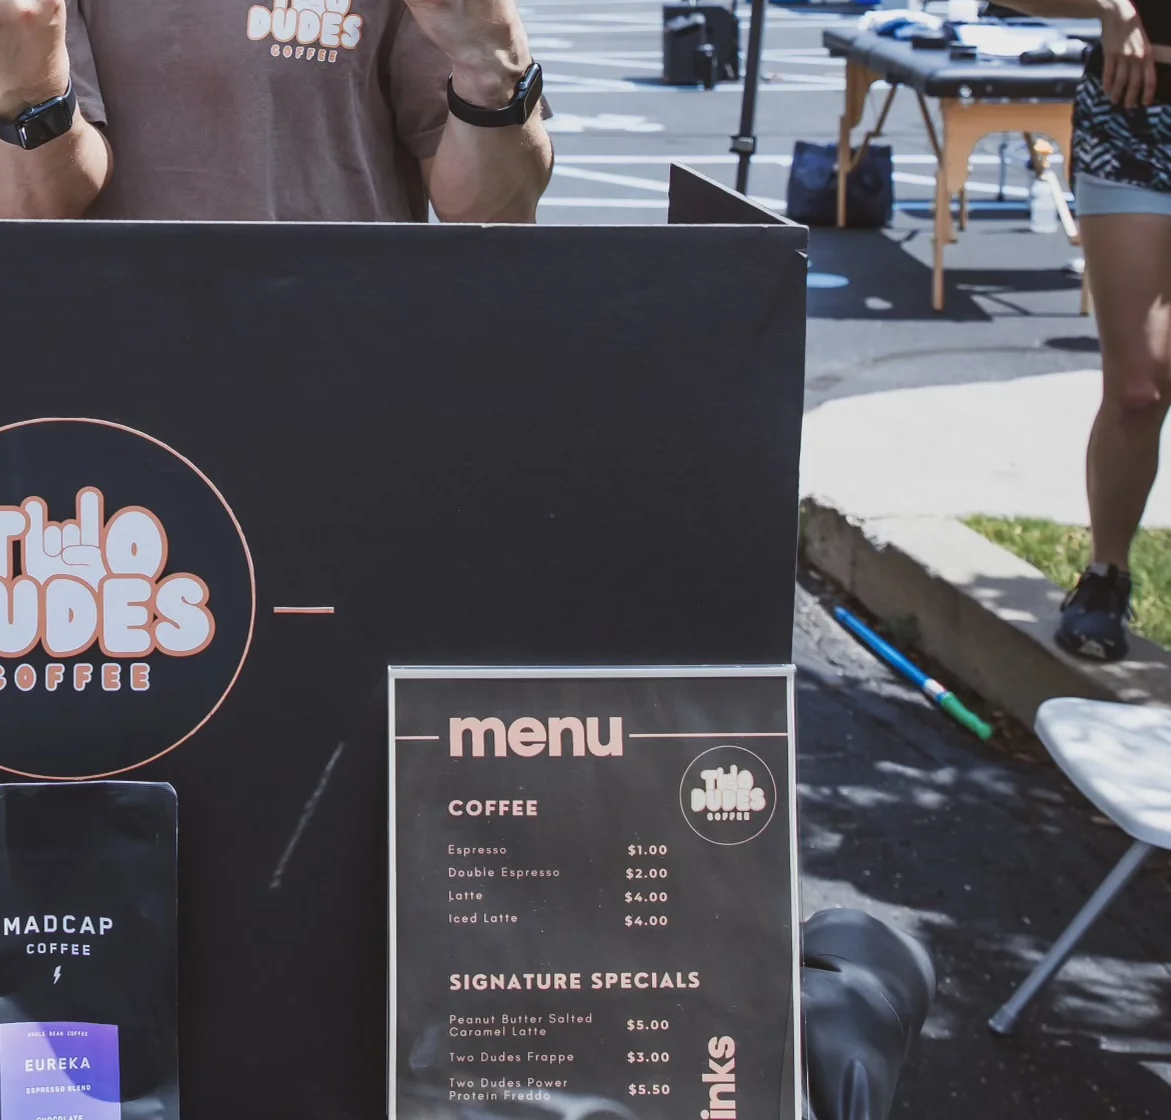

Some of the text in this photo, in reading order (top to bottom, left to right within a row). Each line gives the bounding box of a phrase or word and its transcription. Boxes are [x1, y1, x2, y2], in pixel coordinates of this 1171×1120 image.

[247, 5, 364, 49] DUDES
[270, 44, 338, 63] COFFEE
[448, 716, 624, 758] menu
[691, 787, 766, 812] DUDES
[448, 799, 539, 817] COFFEE
[706, 812, 750, 821] COFFEE
[448, 844, 668, 857] Espresso $1.00
[448, 867, 668, 880] Double Espresso $2.00
[448, 890, 668, 903] Latte $4.00
[3, 914, 113, 936] MADCAP
[448, 912, 668, 927] Iced Latte $4.00
[26, 942, 91, 956] COFFEE
[449, 971, 701, 991] SIGNATURE SPECIALS
[449, 1013, 593, 1025] Peanut Butter Salted
[626, 1019, 670, 1031] $5.00
[449, 1026, 547, 1037] Caramel Latte
[25, 1056, 91, 1072] EUREKA
[449, 1051, 670, 1064] Two Dudes Frappe $3.00
[449, 1077, 569, 1088] Two Dudes Power
[26, 1084, 92, 1095] ESPRESSO BLEND
[449, 1089, 552, 1101] Protein Freddo
[628, 1083, 671, 1096] $5.50
